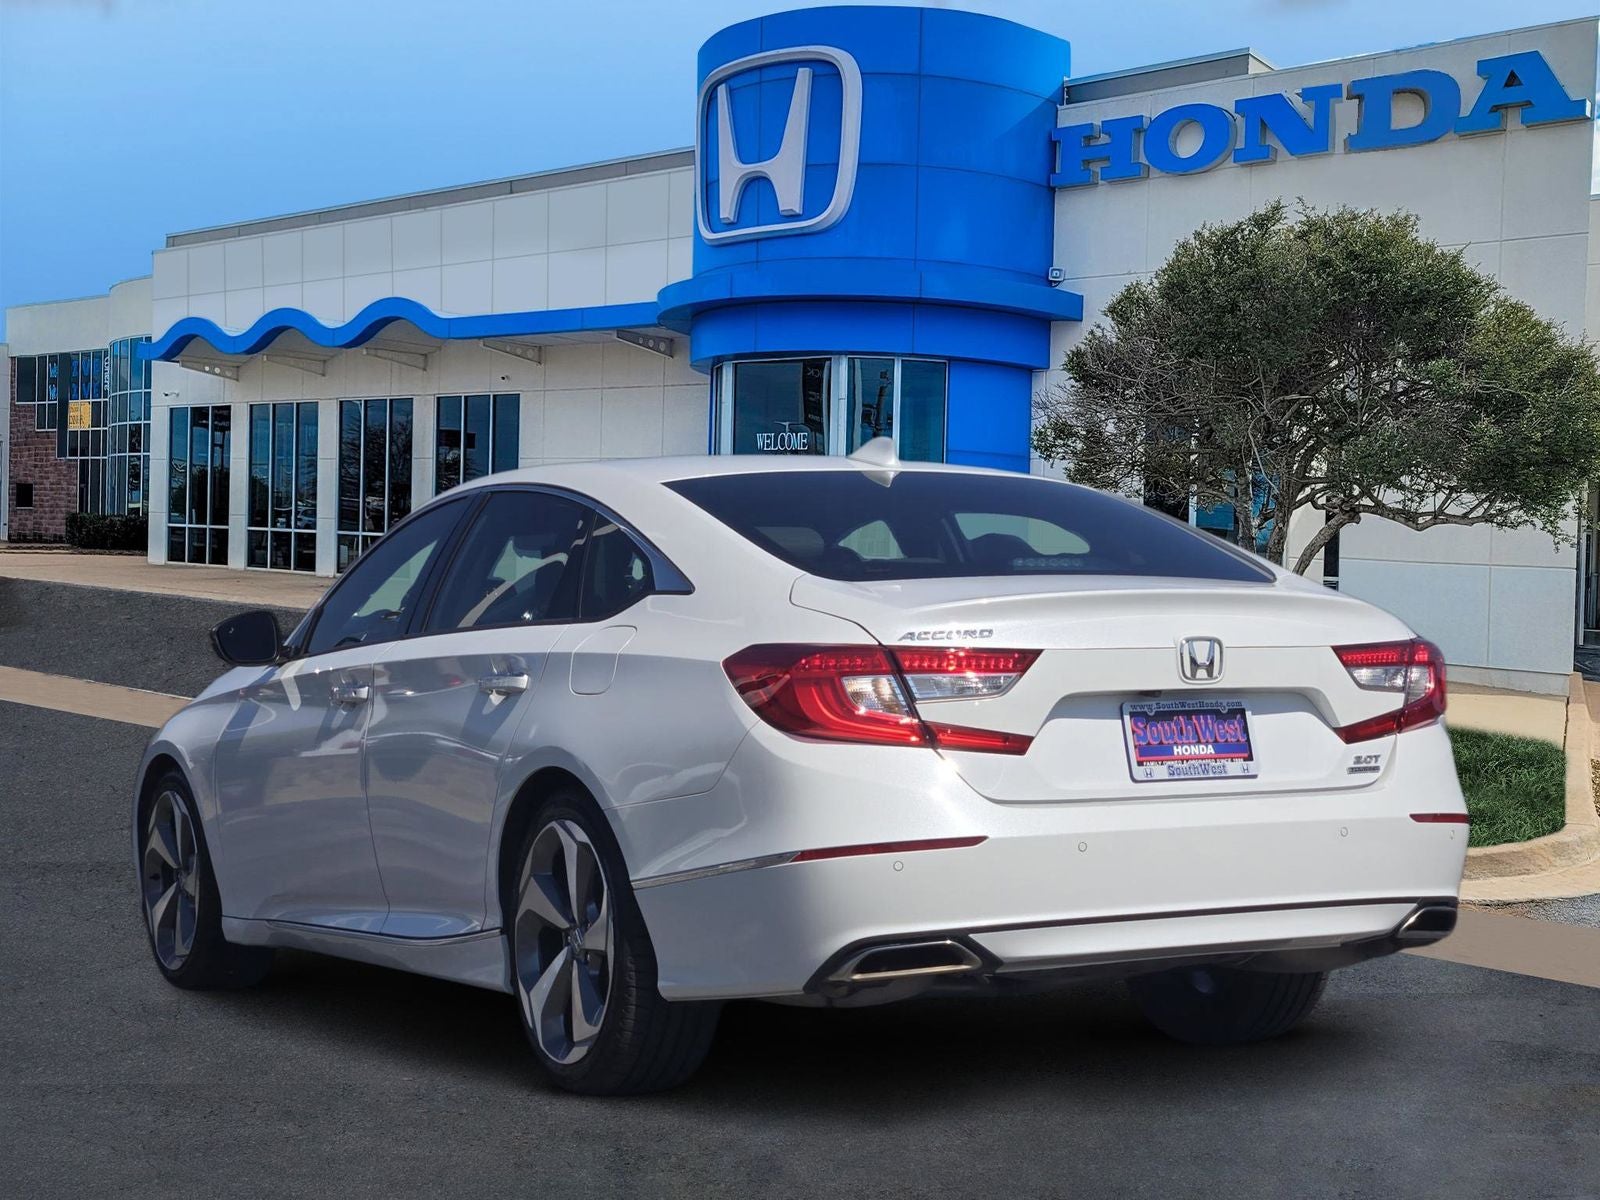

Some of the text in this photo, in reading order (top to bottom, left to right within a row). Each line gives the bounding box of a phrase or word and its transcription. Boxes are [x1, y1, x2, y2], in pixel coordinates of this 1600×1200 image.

[1050, 50, 1591, 187] HONDA
[756, 432, 808, 451] WELCOME
[897, 629, 994, 641] ACCORD
[1131, 714, 1247, 745] SouthWest
[1173, 744, 1215, 755] HONDA
[1167, 762, 1229, 777] SouthWest
